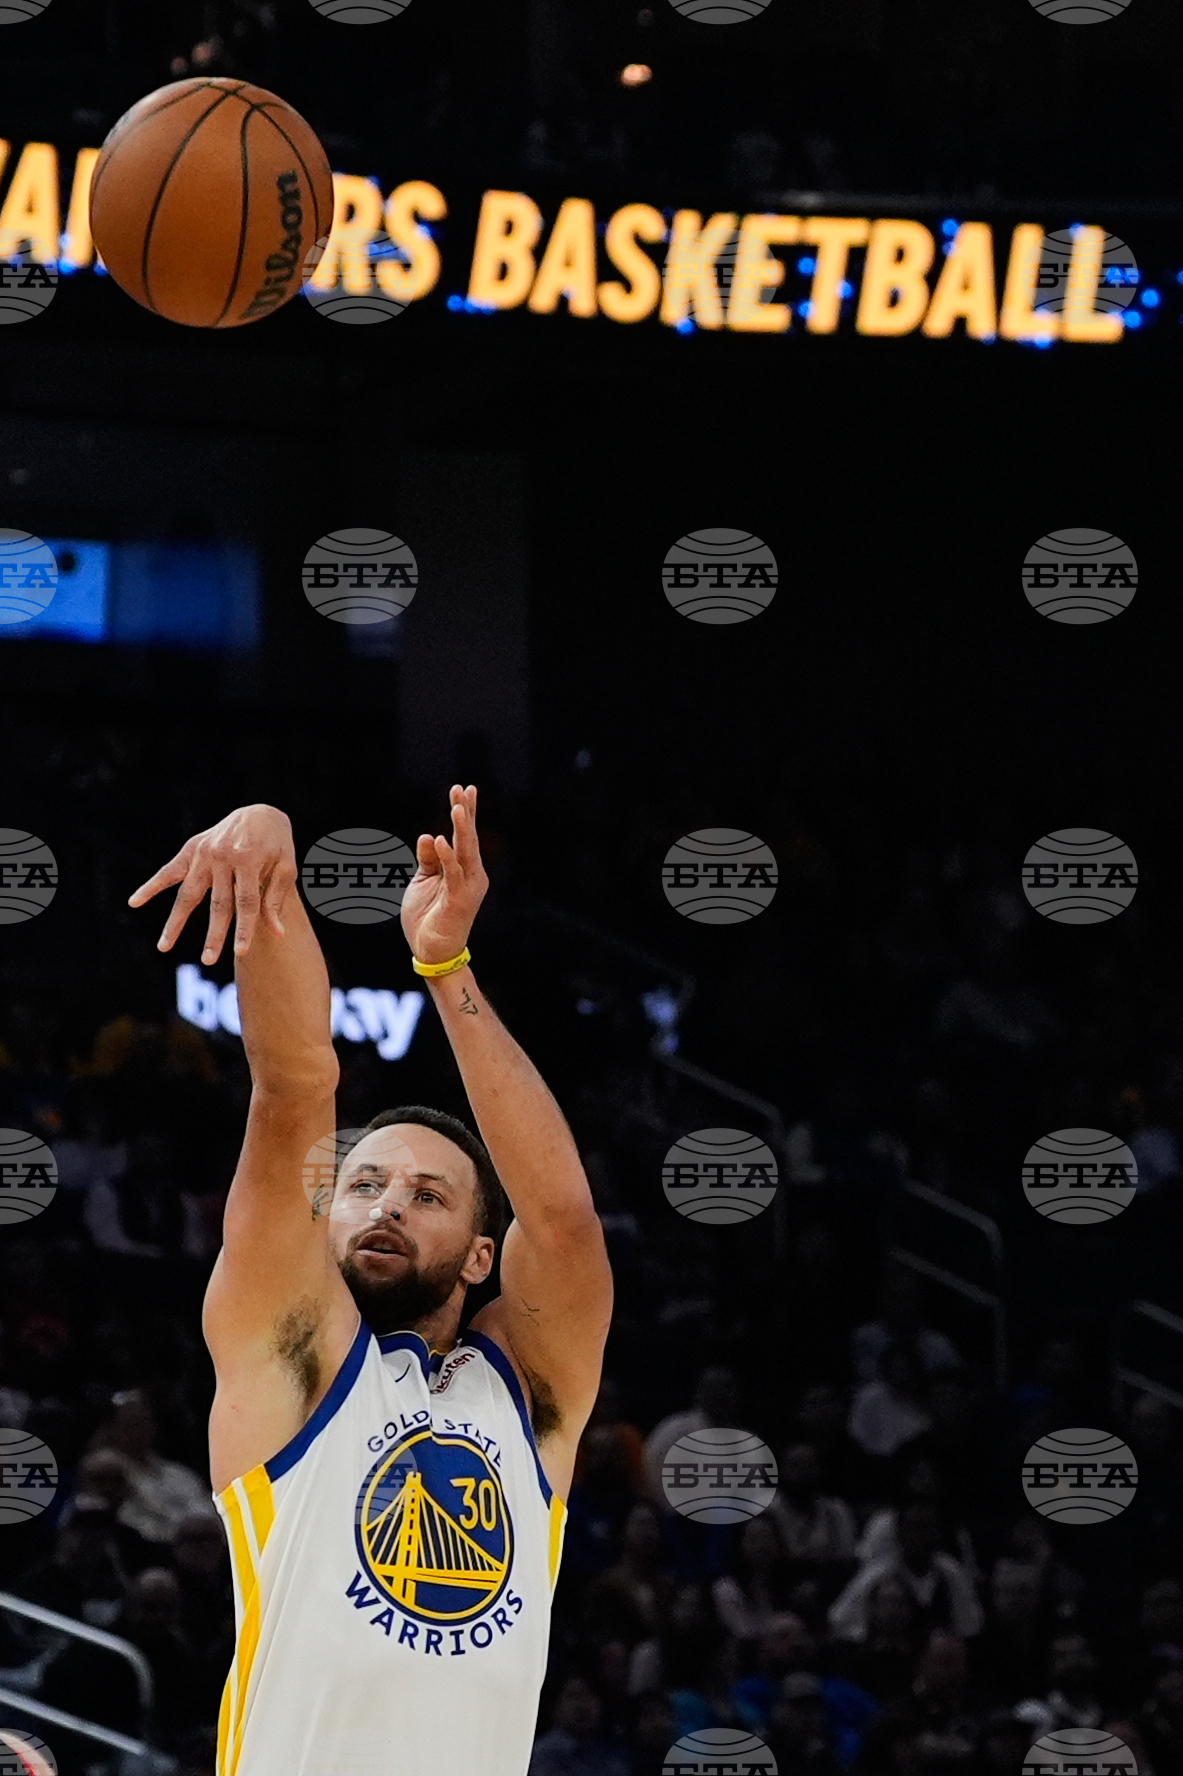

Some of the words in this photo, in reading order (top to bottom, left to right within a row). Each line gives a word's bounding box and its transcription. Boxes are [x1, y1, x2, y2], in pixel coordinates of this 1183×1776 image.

[239, 170, 304, 320] Wilson
[467, 189, 1125, 343] BASKETBALL
[430, 1353, 475, 1394] kuten
[367, 1410, 433, 1453] GOLD
[450, 1477, 497, 1531] 30
[344, 1570, 523, 1657] WARRIORS
